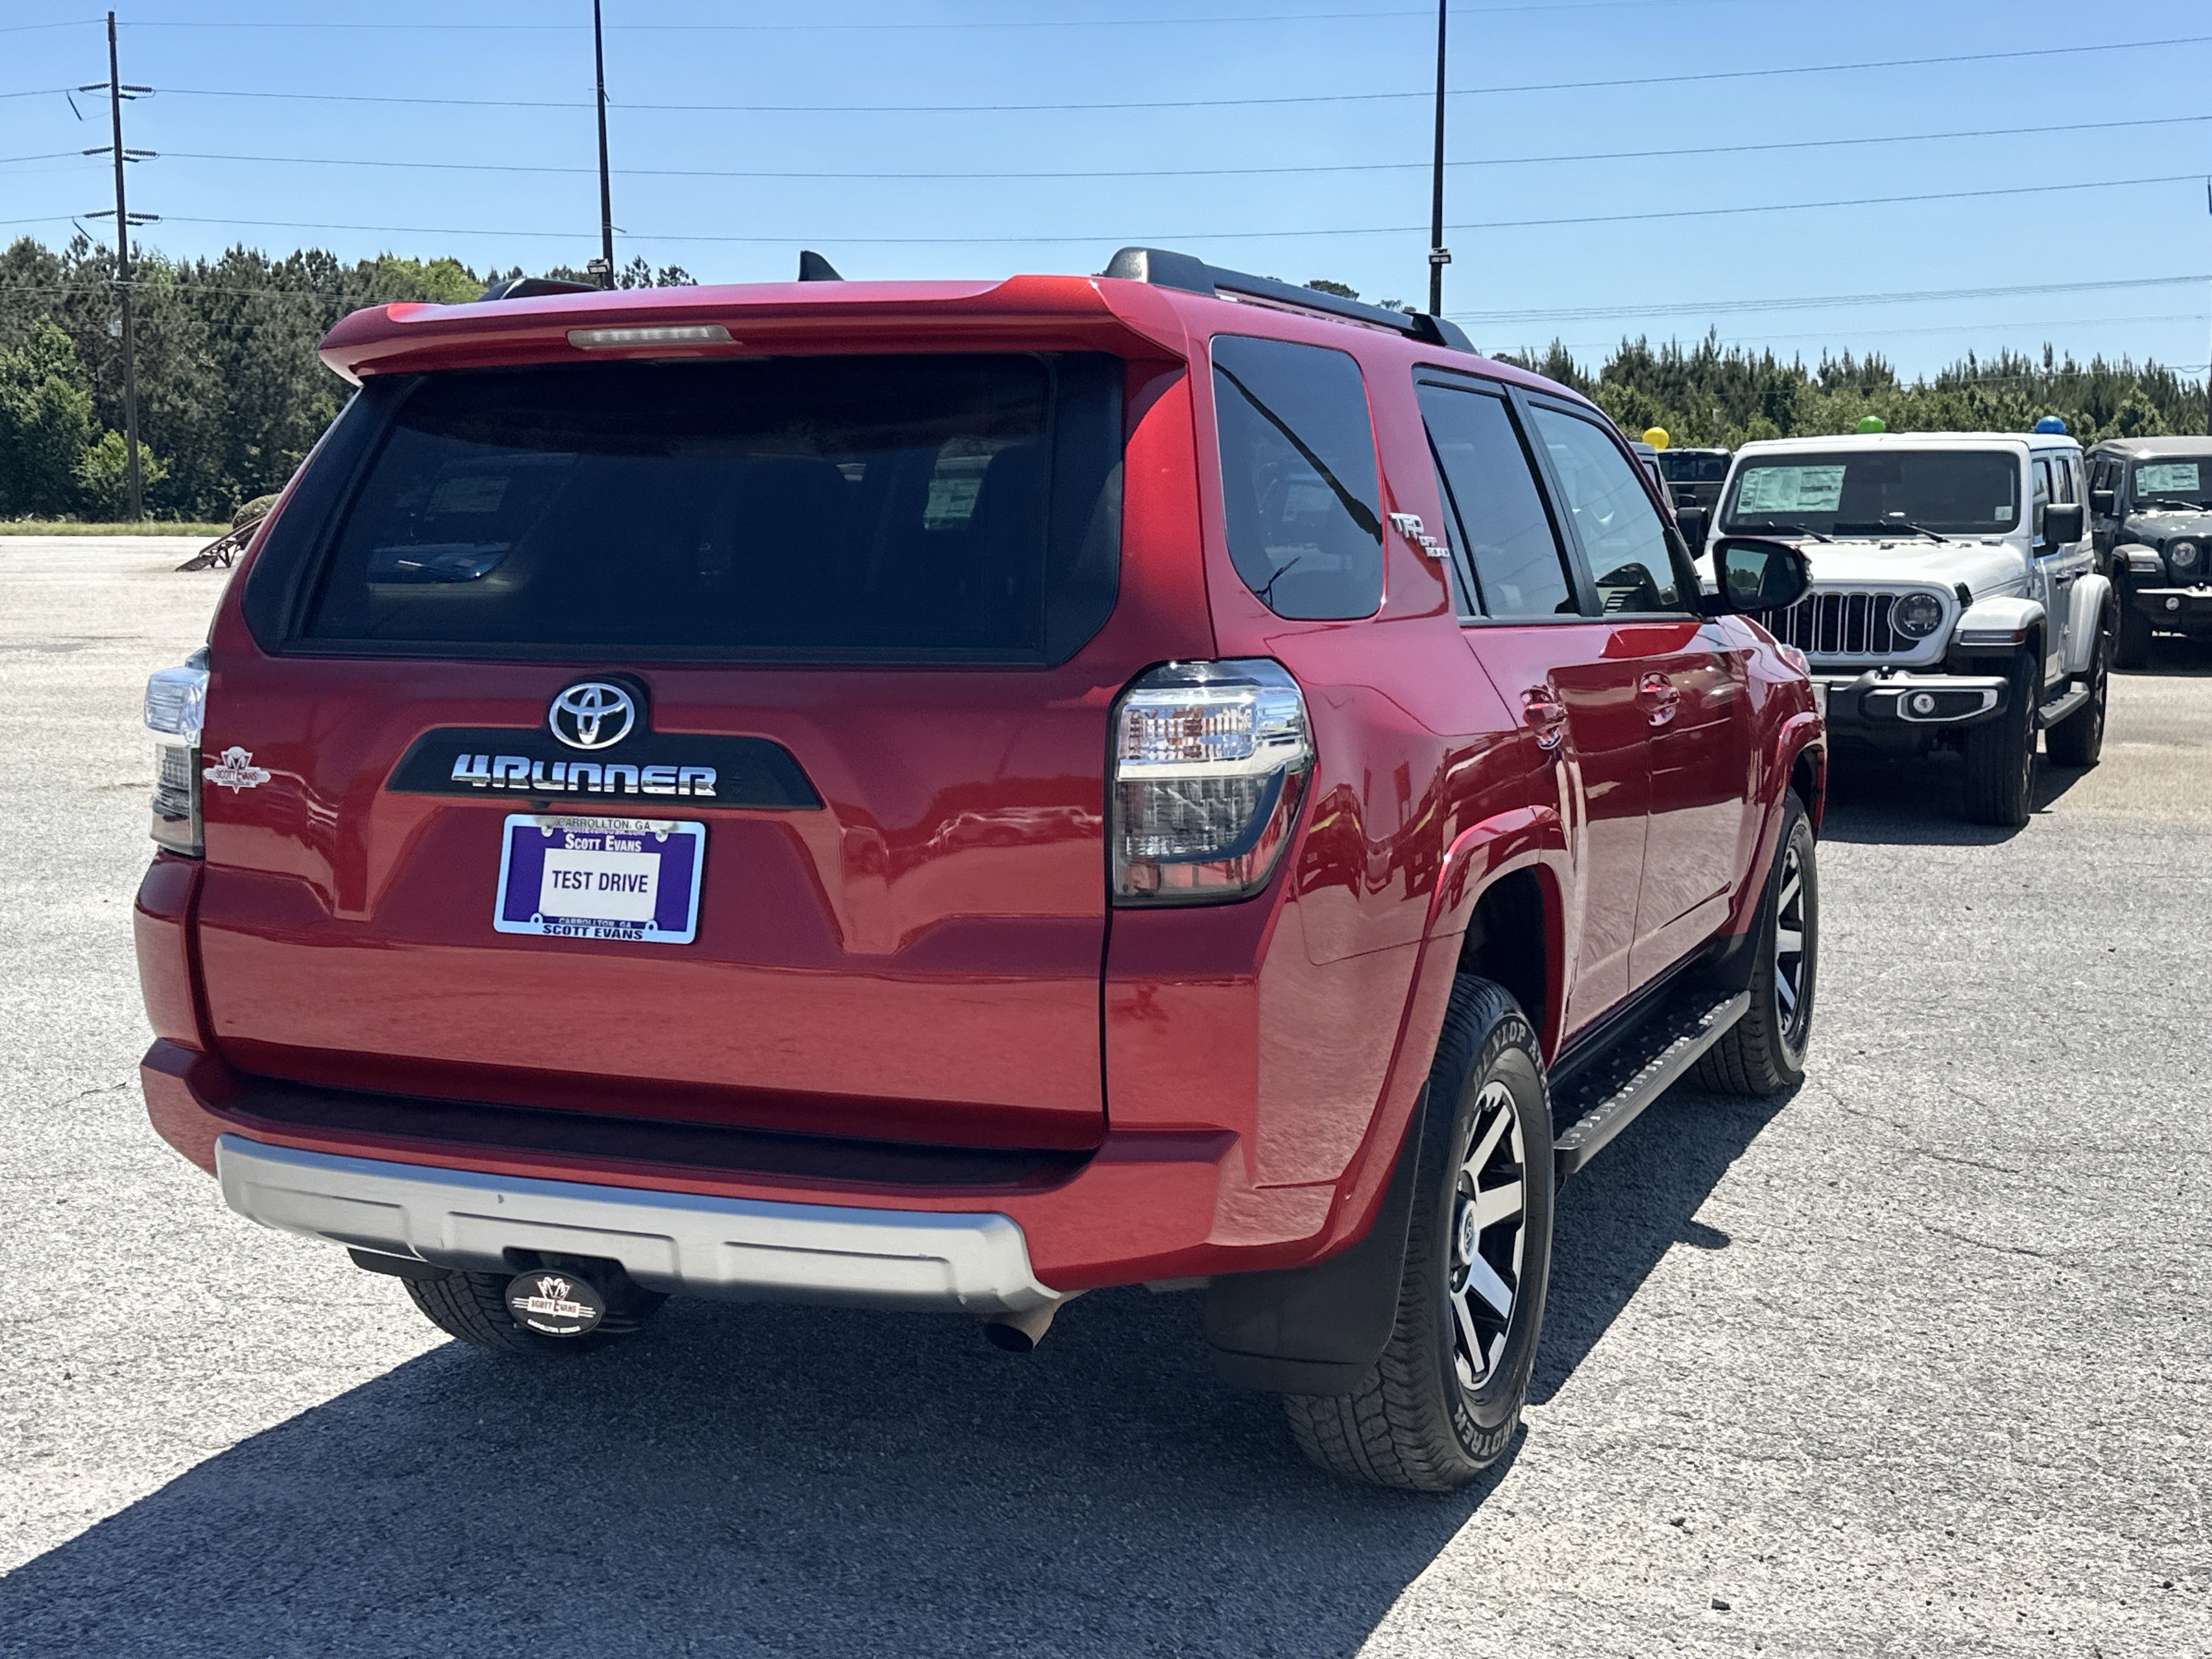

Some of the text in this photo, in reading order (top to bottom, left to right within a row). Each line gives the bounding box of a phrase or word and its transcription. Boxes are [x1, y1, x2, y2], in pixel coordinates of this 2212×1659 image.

[1389, 512, 1424, 540] TRD
[635, 821, 651, 830] GA
[552, 870, 648, 893] TEST DRIVE
[543, 924, 643, 940] SCOTT EVANS
[531, 1299, 577, 1313] SCOTT EVANS
